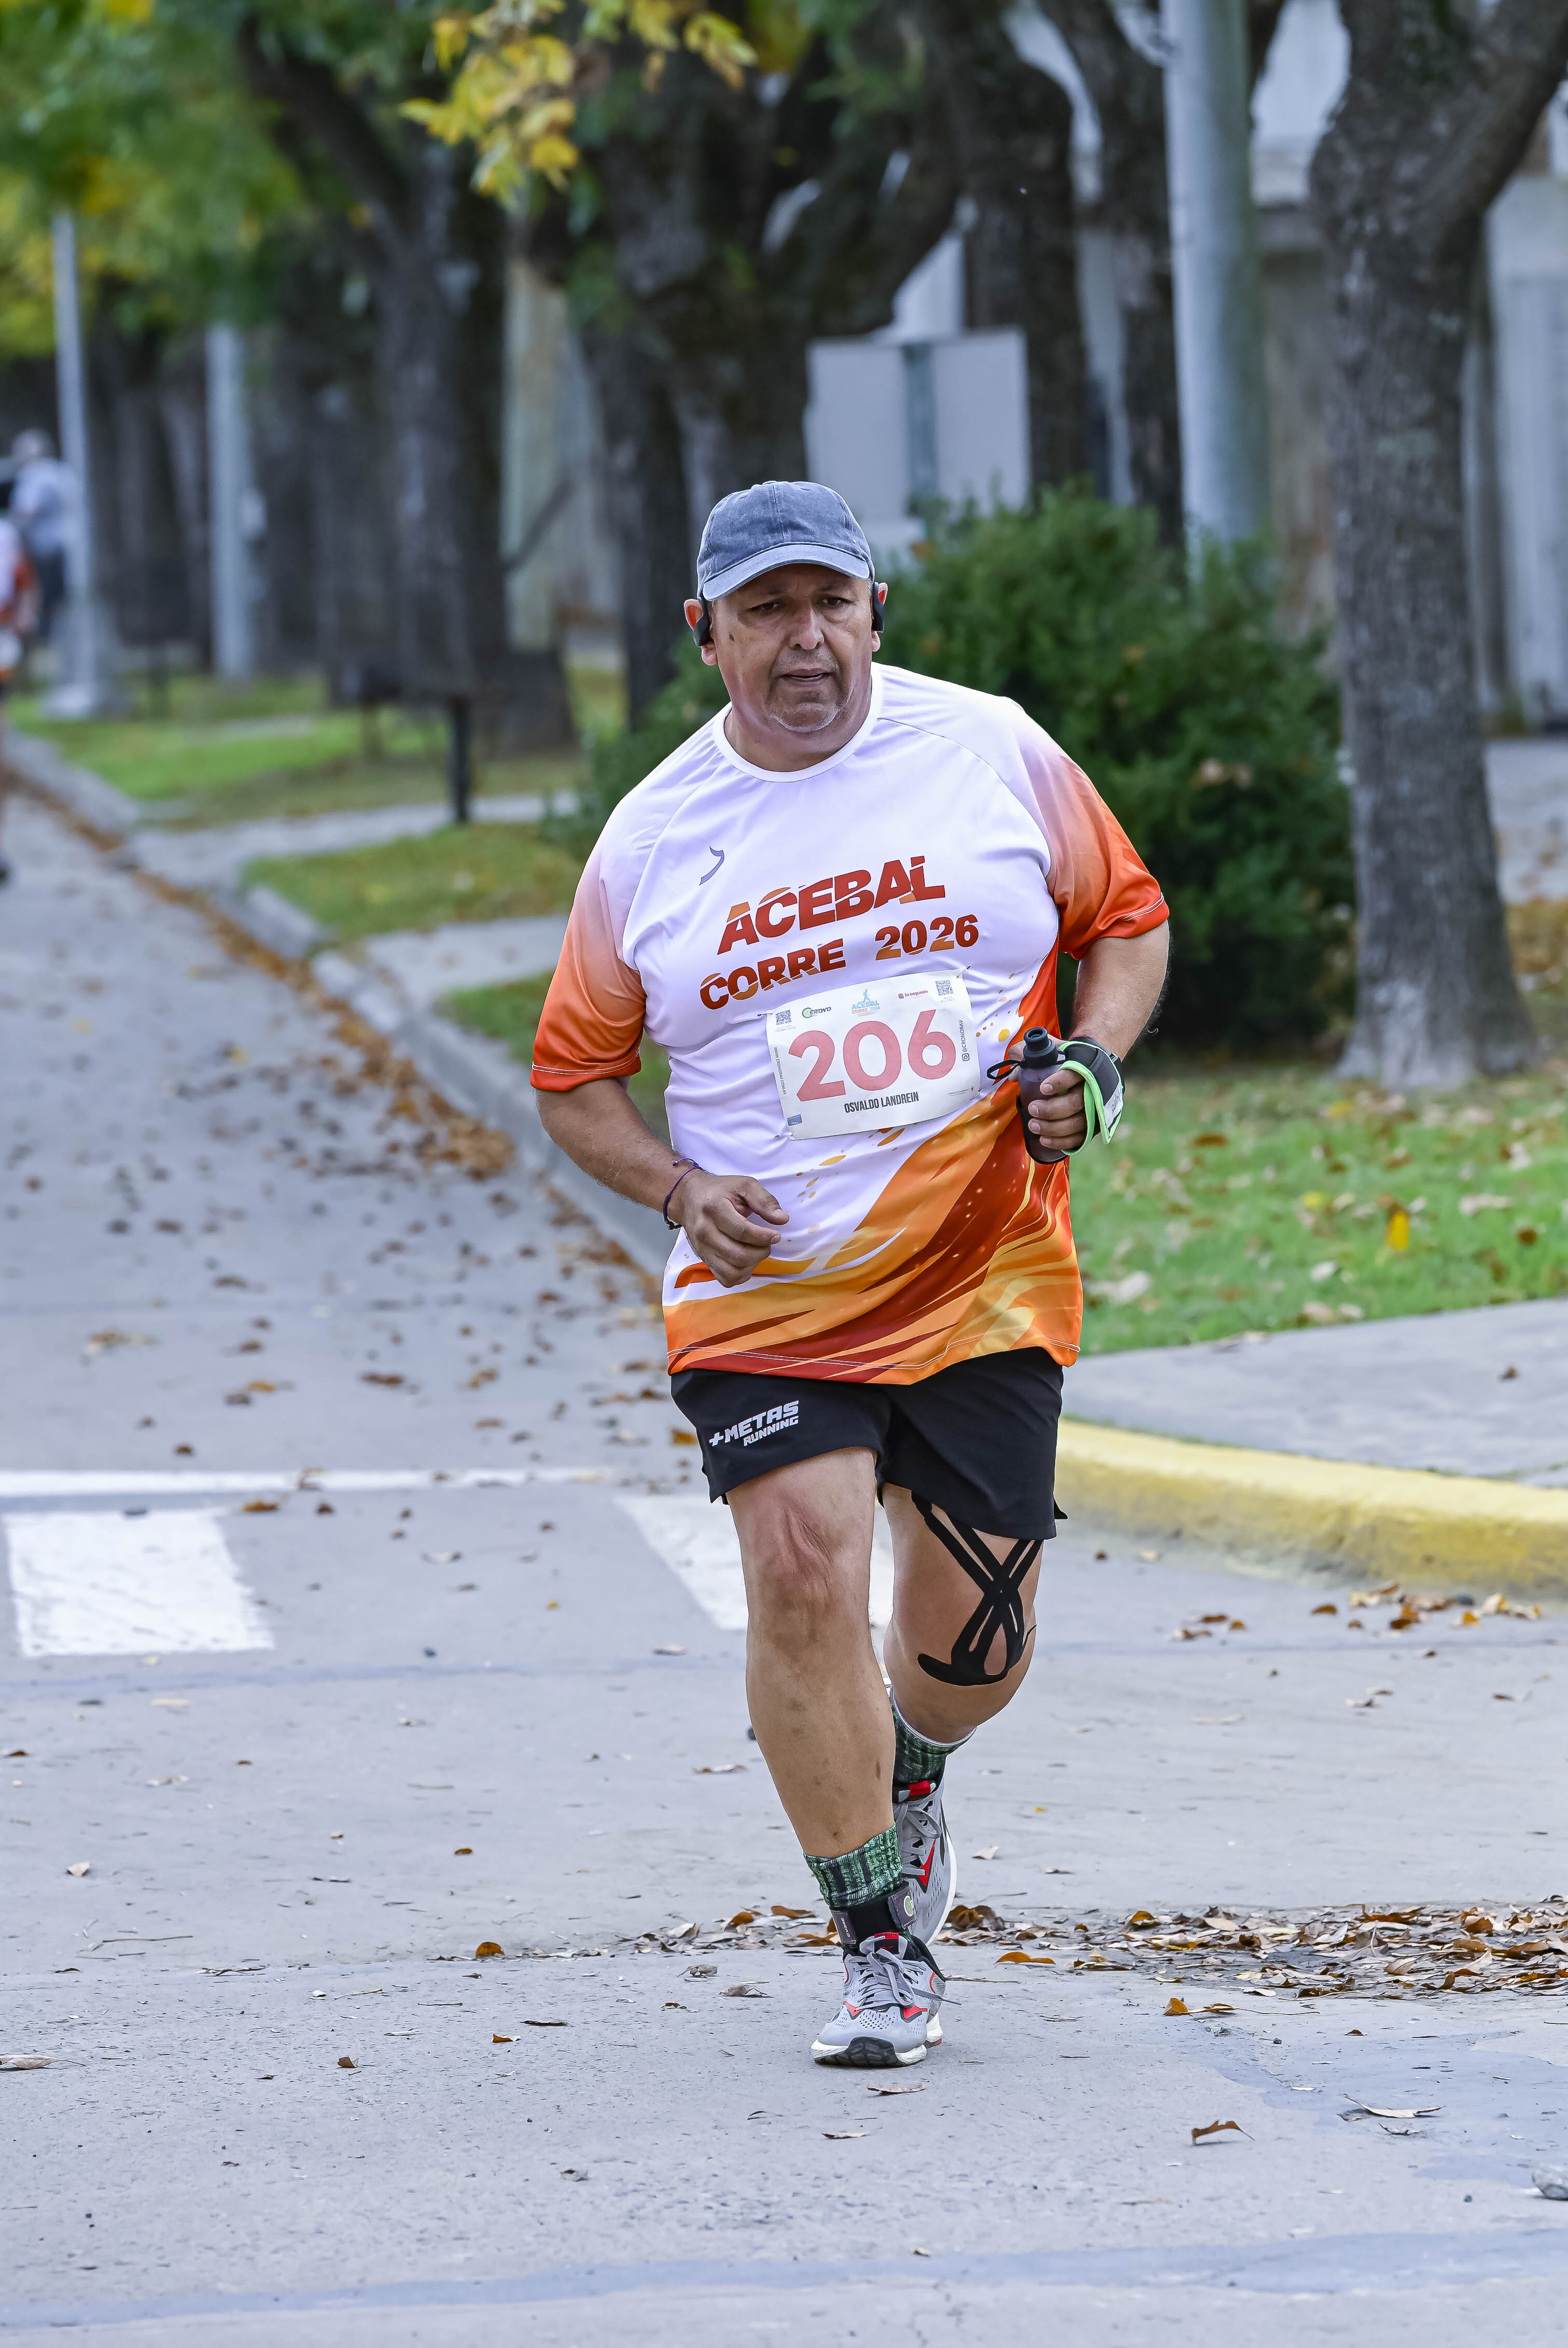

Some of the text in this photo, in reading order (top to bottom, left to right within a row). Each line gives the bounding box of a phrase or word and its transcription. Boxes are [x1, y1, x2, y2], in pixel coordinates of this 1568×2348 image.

[717, 856, 945, 955] ACEBAL
[699, 914, 979, 1010] CORRE 2026
[852, 1000, 879, 1010] ACEBAL
[958, 1020, 967, 1052] @CRONORAV
[788, 1009, 956, 1101] 206
[844, 1092, 919, 1113] OSVALDO LANDREIN
[744, 1416, 799, 1446] RUNNING
